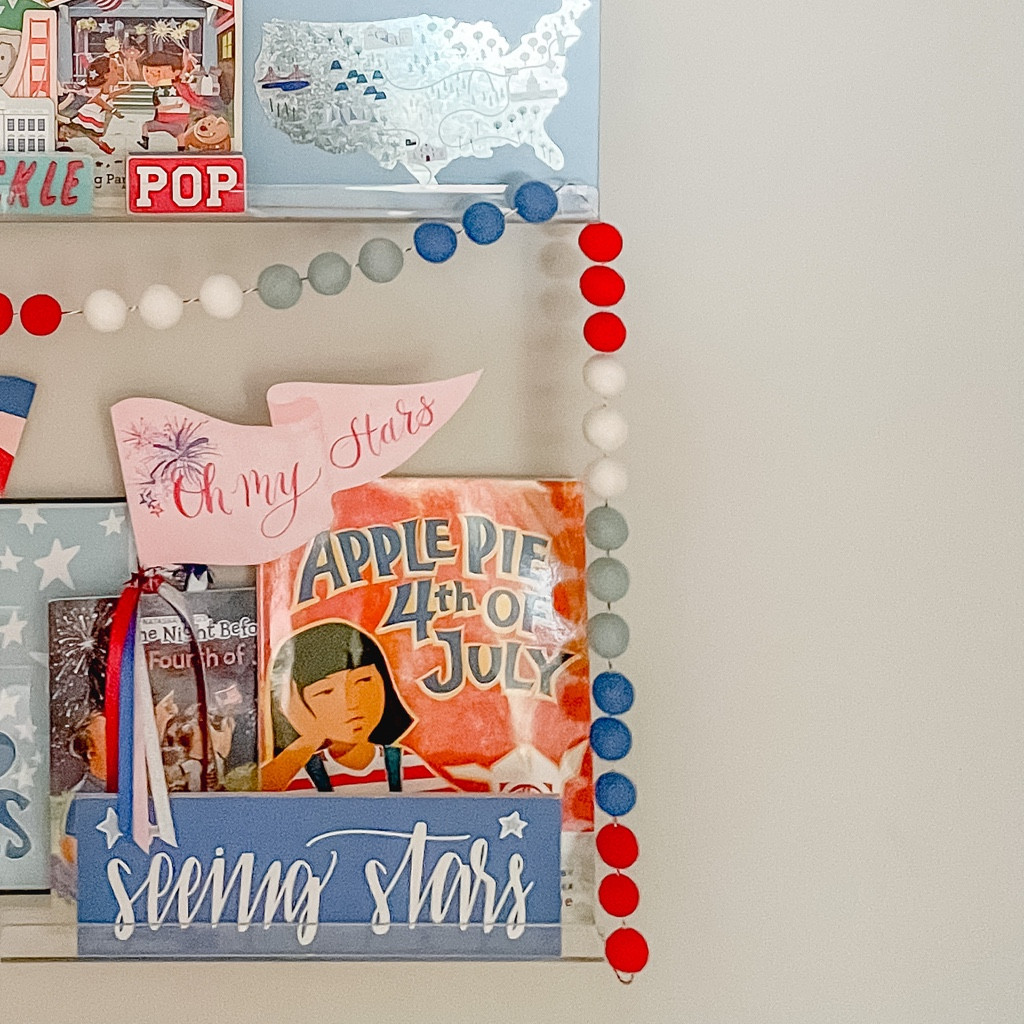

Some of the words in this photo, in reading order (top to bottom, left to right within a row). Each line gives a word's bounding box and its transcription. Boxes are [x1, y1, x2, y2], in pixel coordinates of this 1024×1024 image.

[136, 166, 238, 208] POP
[171, 462, 232, 518] Oh
[330, 395, 435, 469] Stars
[298, 519, 457, 604] APPLE
[465, 515, 549, 579] PIE
[382, 579, 476, 642] 4th
[487, 588, 553, 634] OF
[223, 642, 246, 665] of
[422, 630, 574, 696] JULY
[107, 847, 338, 946] seeing
[306, 821, 534, 936] stars
